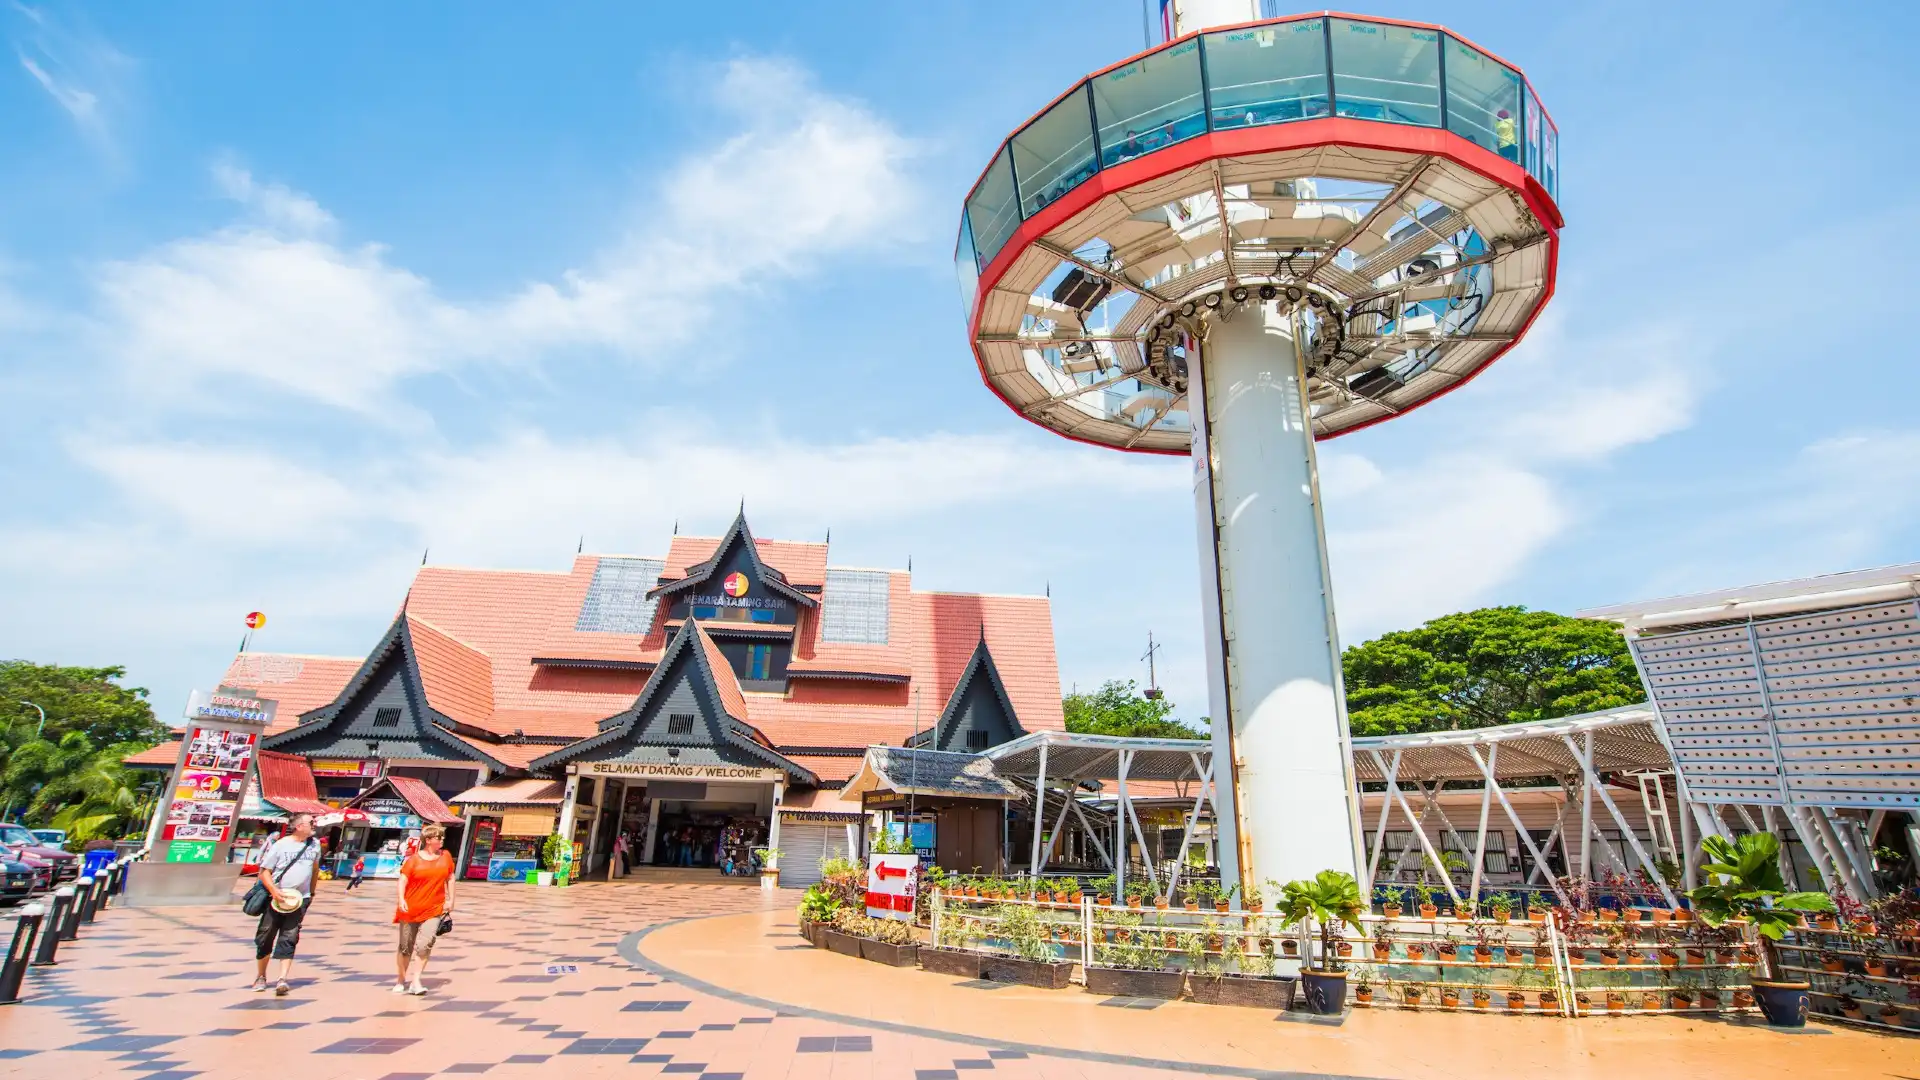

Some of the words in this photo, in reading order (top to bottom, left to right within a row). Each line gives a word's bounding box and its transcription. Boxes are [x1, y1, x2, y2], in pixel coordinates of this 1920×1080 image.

[683, 594, 724, 606] MENARA
[726, 597, 762, 609] TAMING
[764, 599, 787, 610] SARI
[212, 696, 261, 710] MENARA
[197, 706, 240, 719] TAMING
[243, 710, 268, 722] SARI
[593, 763, 646, 775] SELAMAT
[648, 765, 693, 776] DATANG
[695, 767, 703, 777] /
[704, 768, 762, 779] WELCOME
